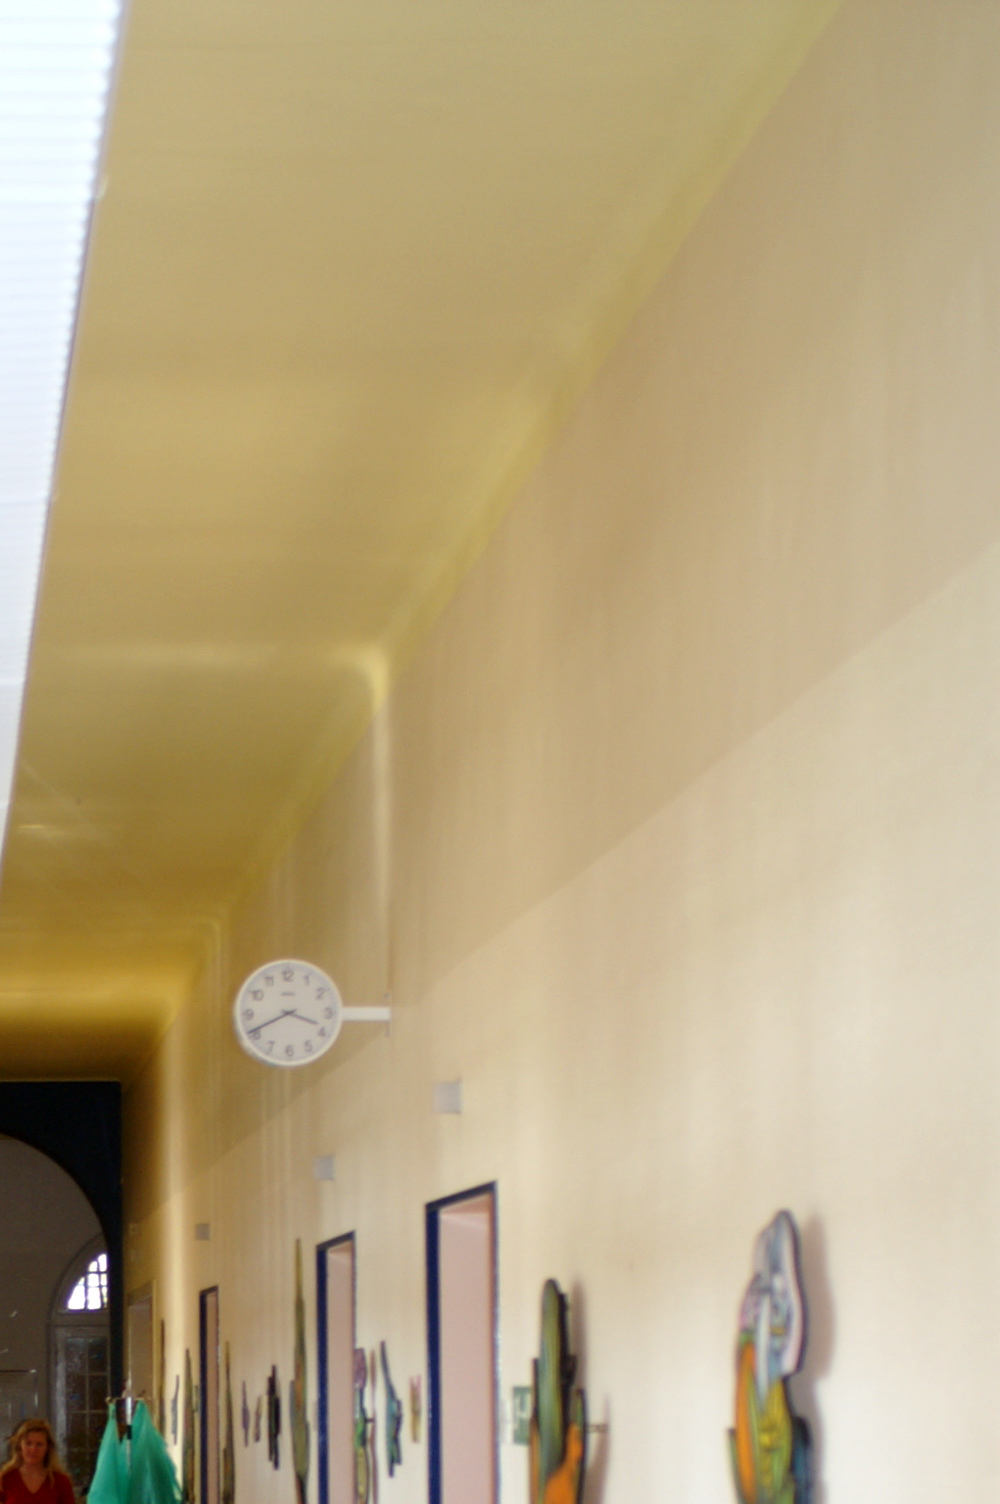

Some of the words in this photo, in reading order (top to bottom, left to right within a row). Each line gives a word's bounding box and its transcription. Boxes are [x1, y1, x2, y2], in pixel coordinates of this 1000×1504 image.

[264, 975, 274, 986] 11
[282, 969, 294, 982] 12
[303, 975, 310, 986] 1
[251, 989, 264, 1001] 10
[316, 987, 326, 1000] 2
[245, 1009, 254, 1021] 9
[325, 1007, 333, 1020] 3
[318, 1026, 326, 1037] 4
[267, 1040, 275, 1053] 7
[285, 1044, 294, 1057] 6
[304, 1039, 313, 1052] 5
